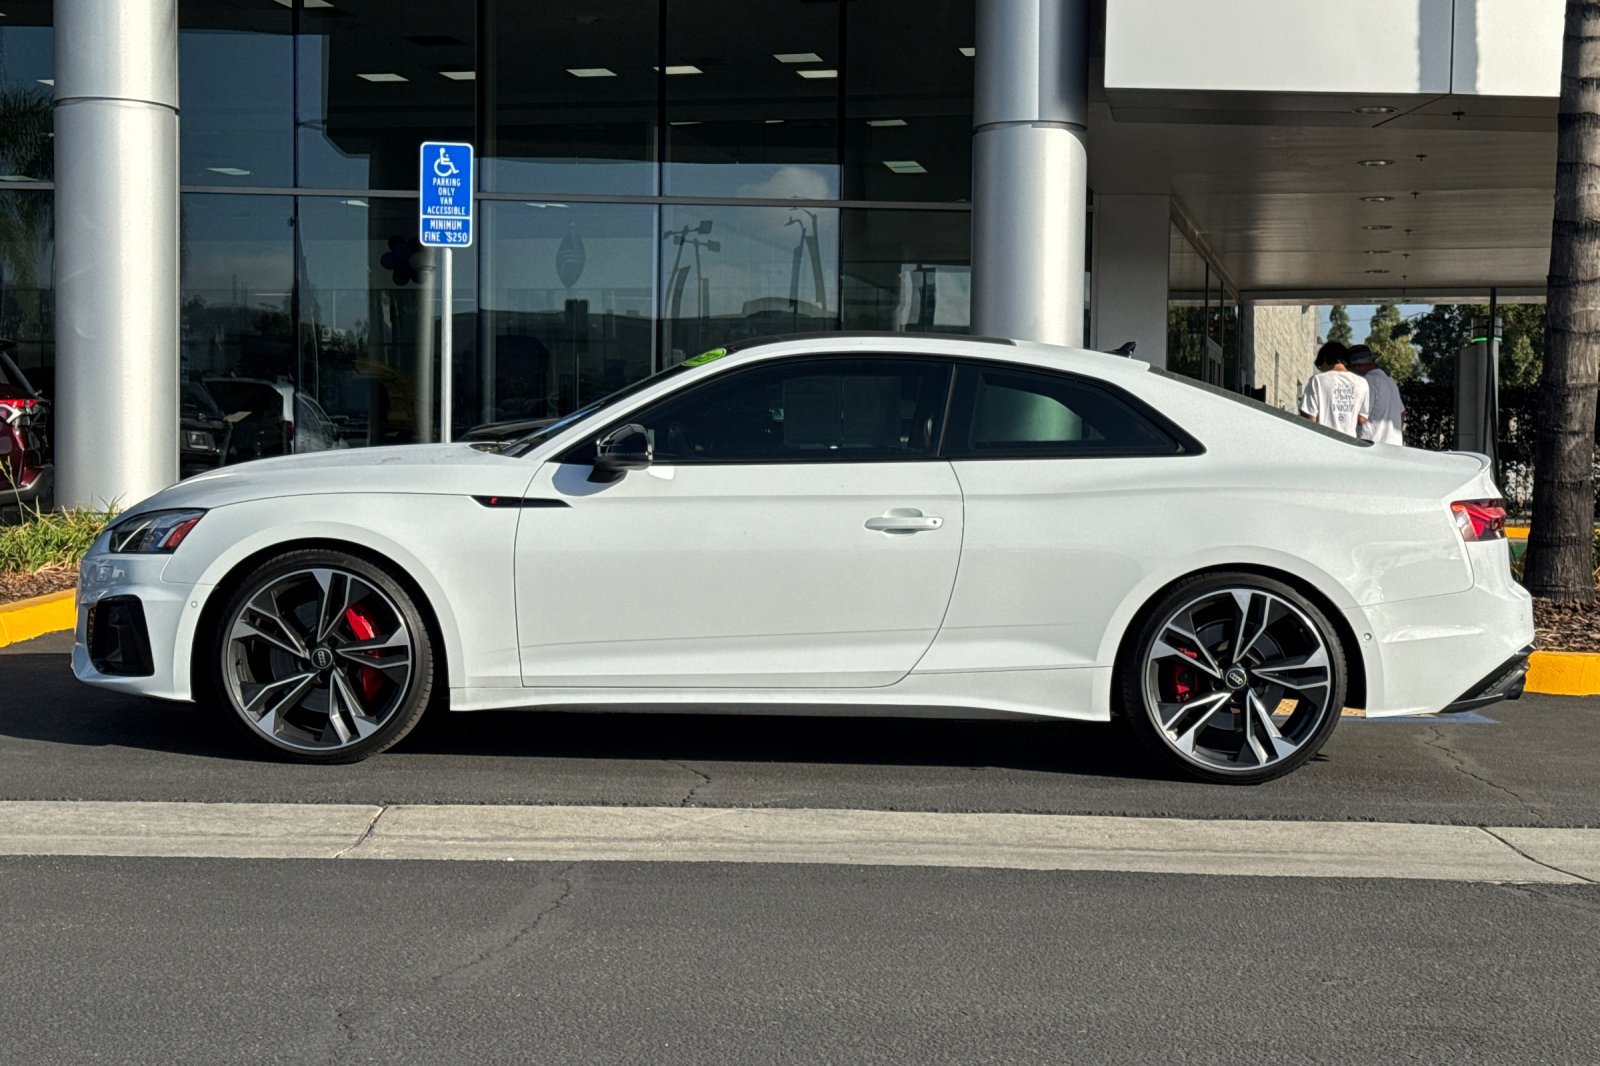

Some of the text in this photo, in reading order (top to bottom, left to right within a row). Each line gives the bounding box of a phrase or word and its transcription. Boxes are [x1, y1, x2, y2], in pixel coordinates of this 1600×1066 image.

[432, 178, 461, 187] PARKING
[438, 187, 456, 196] ONLY
[439, 197, 453, 205] VAN
[427, 206, 466, 215] ACCESSIBLE
[430, 219, 462, 230] MINIMUM
[424, 231, 468, 243] FINE $250
